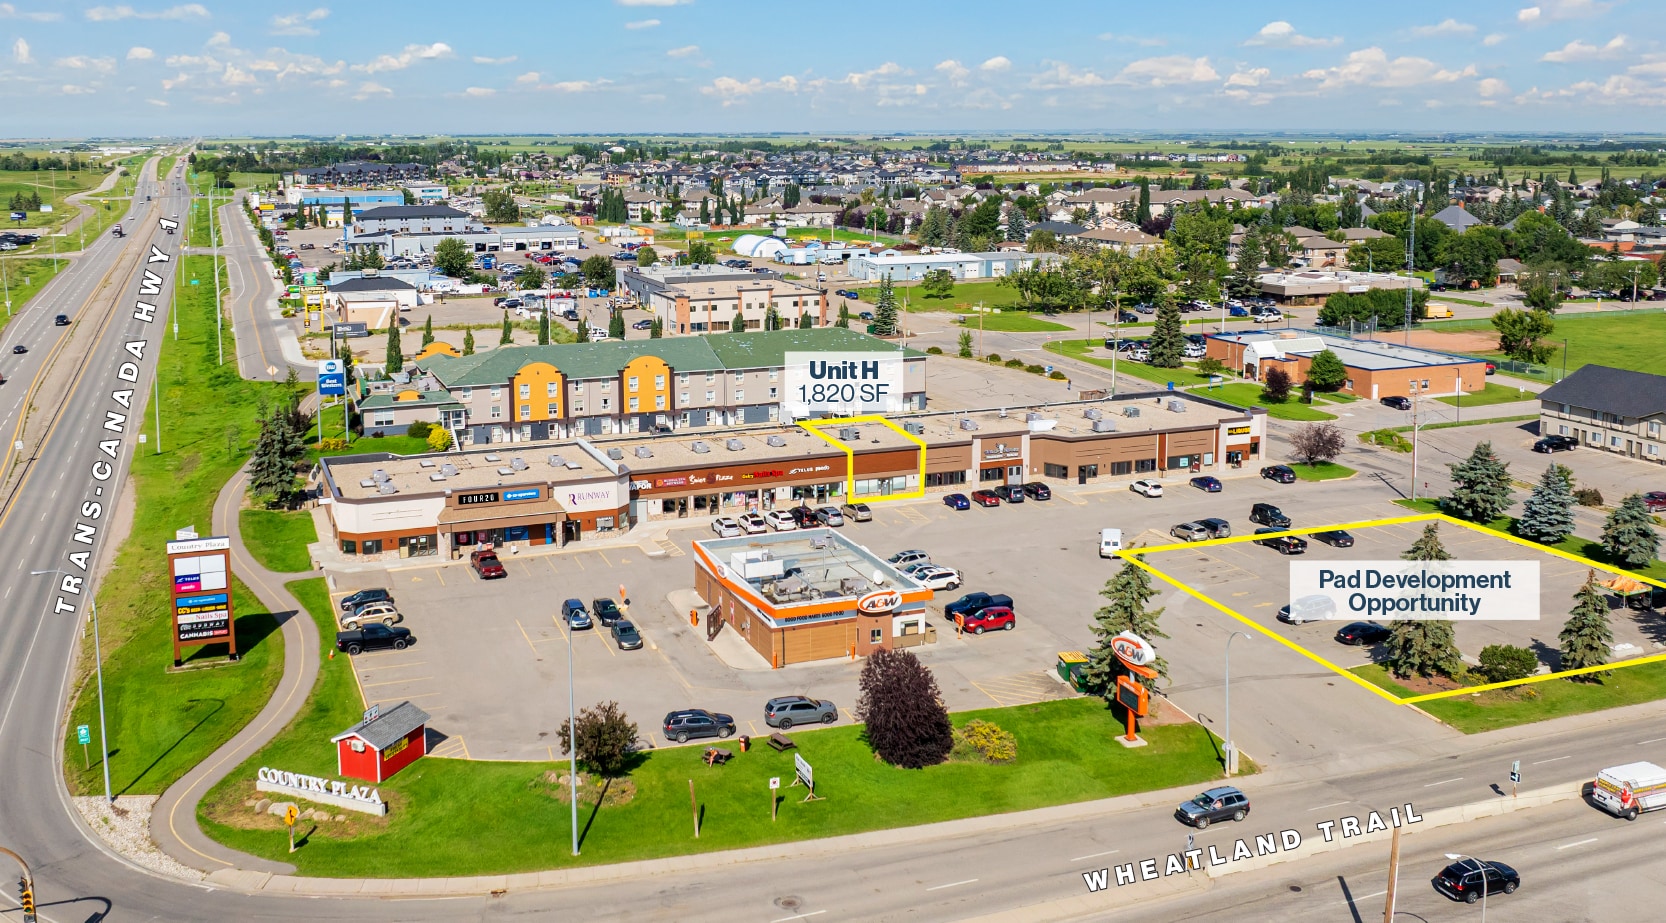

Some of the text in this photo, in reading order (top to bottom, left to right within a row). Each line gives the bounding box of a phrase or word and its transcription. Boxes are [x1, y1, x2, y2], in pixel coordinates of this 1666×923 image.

[577, 491, 610, 500] RUNWAY
[171, 543, 202, 551] Country
[866, 596, 899, 610] A&W
[180, 630, 213, 639] CANNABIS
[1117, 643, 1144, 662] A&W
[258, 767, 382, 804] COUNTRY PLAZA
